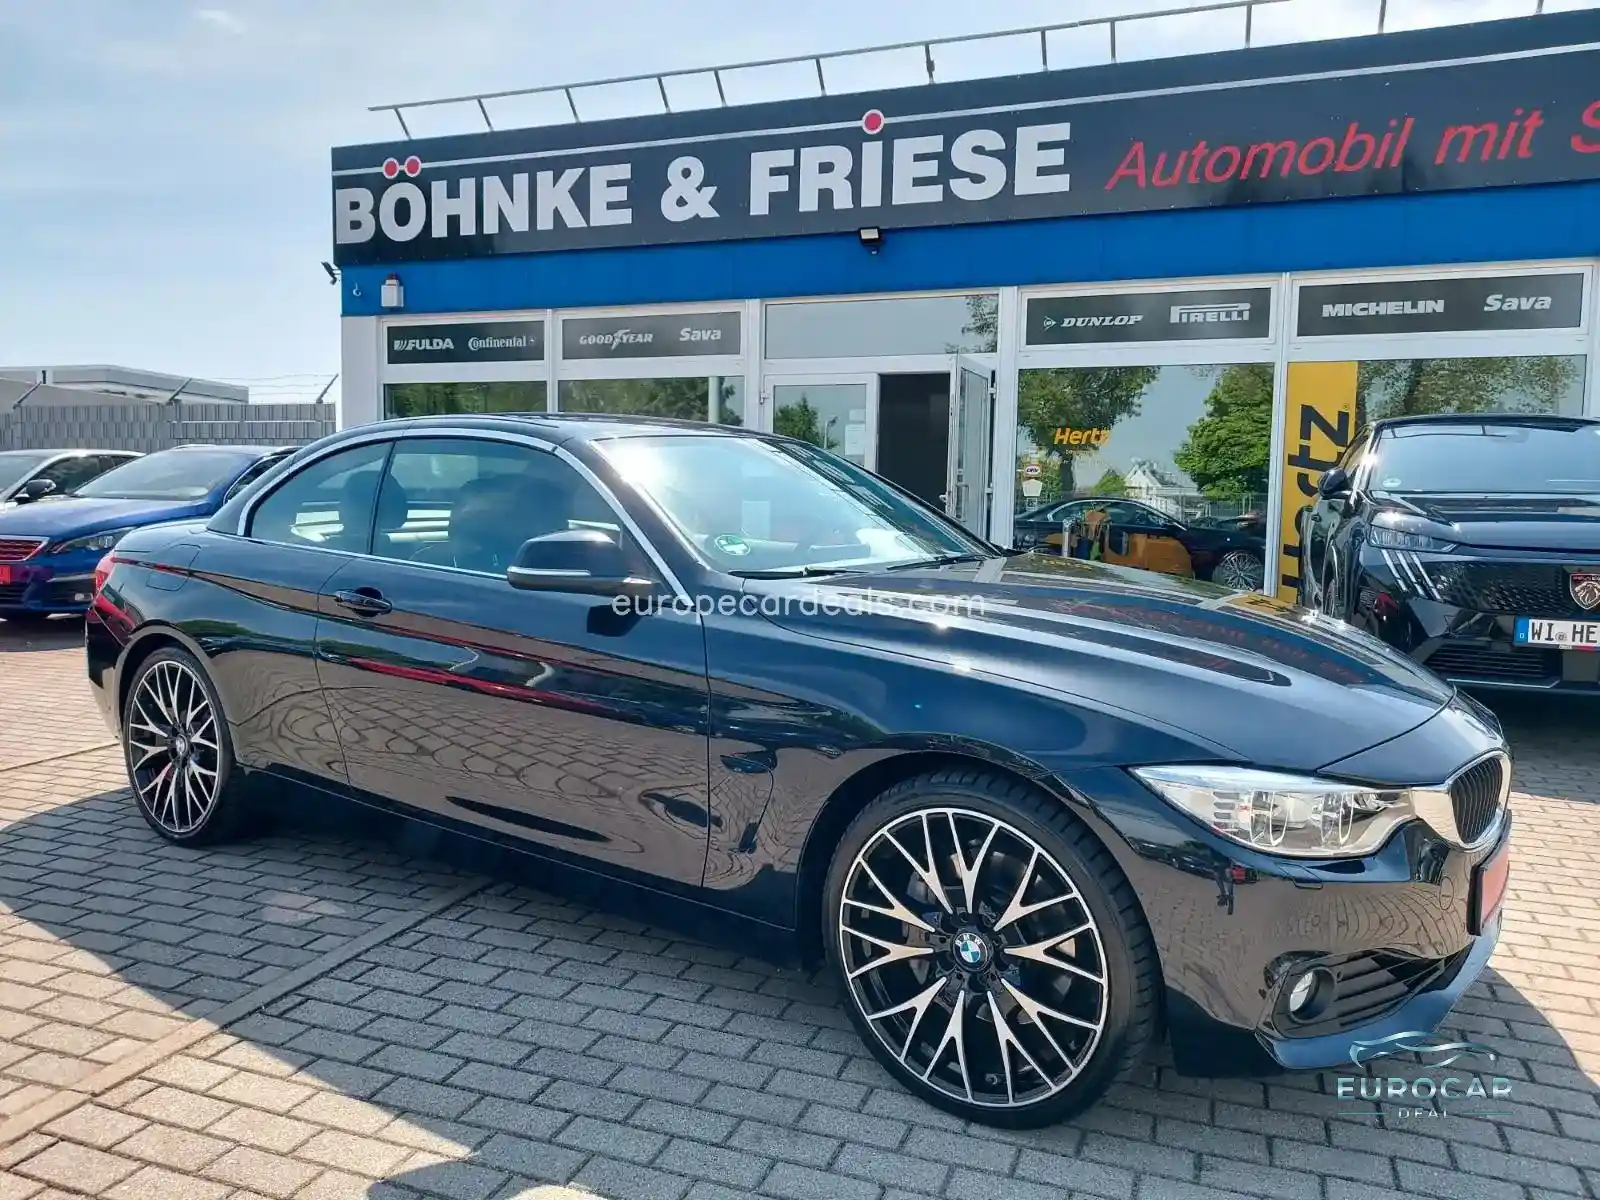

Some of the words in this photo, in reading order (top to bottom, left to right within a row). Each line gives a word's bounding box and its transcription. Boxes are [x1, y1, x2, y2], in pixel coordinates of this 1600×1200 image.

[1105, 117, 1416, 191] Automobil
[1434, 107, 1545, 166] mit
[335, 155, 632, 244] BÖHNKE
[660, 155, 721, 222] &
[1060, 314, 1145, 328] DUNLOP
[1169, 302, 1252, 324] PIRELLI
[1322, 299, 1445, 318] MICHELIN
[1483, 293, 1553, 312] Sava
[402, 338, 455, 351] FULDA
[468, 334, 527, 351] Continental
[679, 327, 722, 342] Sava
[1053, 427, 1111, 445] Hertz
[1531, 621, 1555, 641] WI
[1571, 623, 1598, 644] HE
